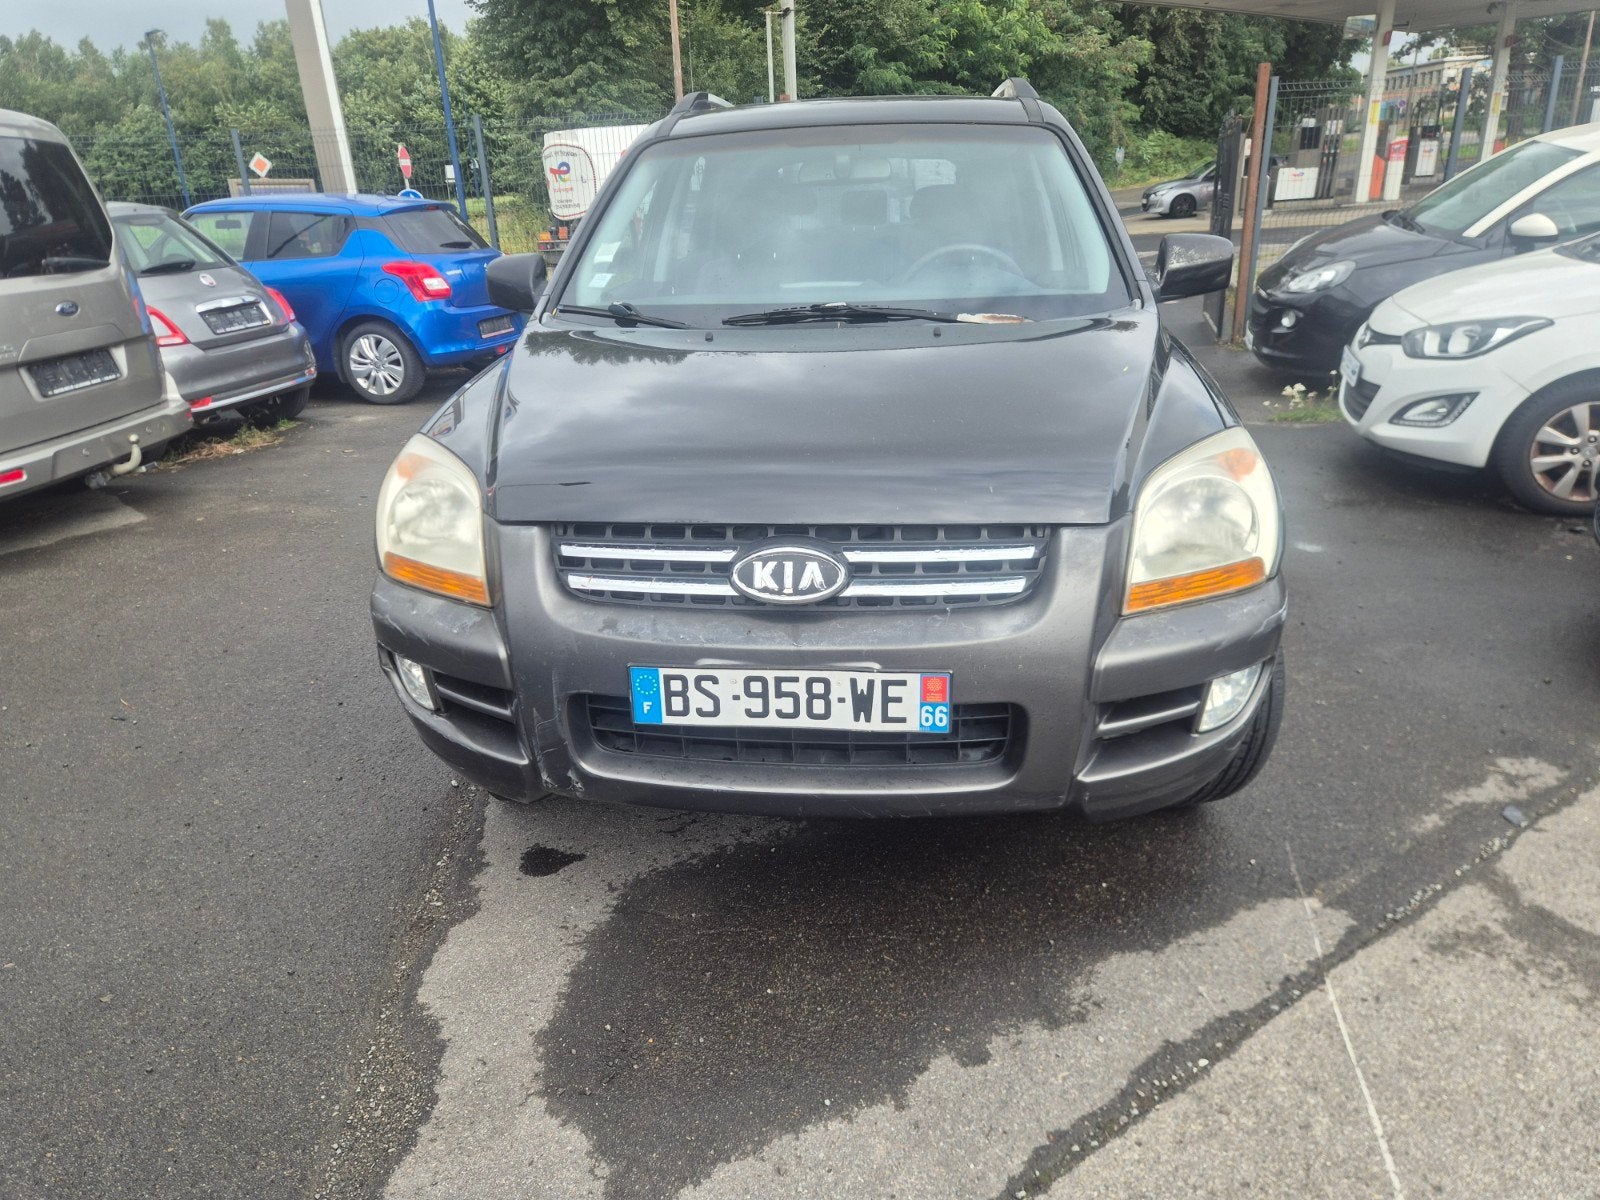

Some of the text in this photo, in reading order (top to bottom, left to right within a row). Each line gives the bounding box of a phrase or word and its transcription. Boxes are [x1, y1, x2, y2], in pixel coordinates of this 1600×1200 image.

[752, 560, 827, 594] KIA
[642, 701, 653, 715] F
[921, 705, 948, 728] 66
